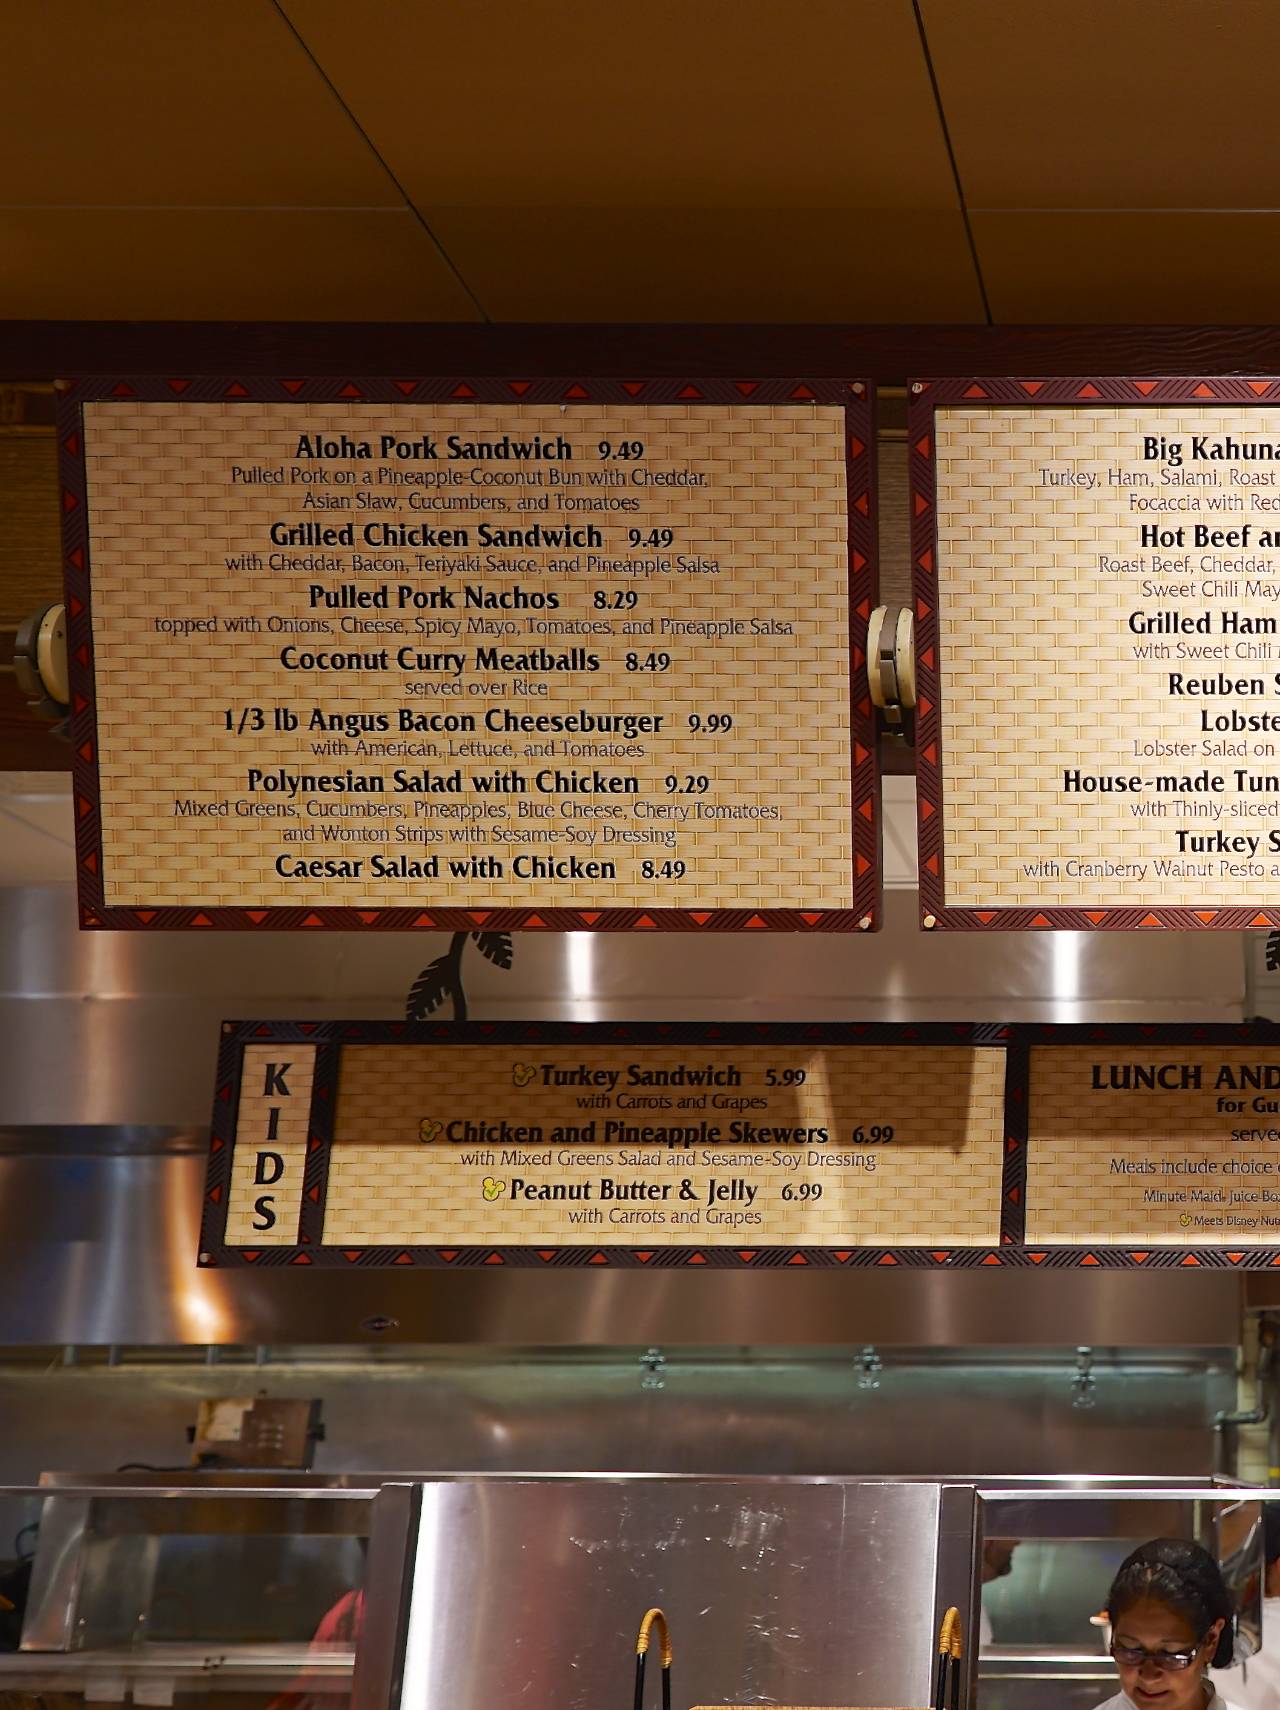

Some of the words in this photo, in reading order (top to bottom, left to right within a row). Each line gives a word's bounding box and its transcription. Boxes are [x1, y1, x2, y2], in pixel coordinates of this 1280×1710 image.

[297, 435, 372, 458] Aloha
[381, 436, 437, 459] Pork
[448, 436, 571, 460] Sandwich
[599, 441, 644, 460] 9.49
[1144, 437, 1183, 466] Big
[232, 467, 283, 483] Pulled
[292, 467, 329, 483] Pork
[335, 472, 355, 483] on
[362, 472, 372, 484] a
[379, 468, 542, 489] Pineapple-Coconut
[550, 468, 581, 484] Bun
[587, 469, 625, 484] with
[632, 469, 708, 487] Cheddar,
[303, 492, 350, 508] Asian
[356, 493, 401, 511] Slaw,
[409, 492, 510, 511] Cucumbers,
[518, 494, 548, 510] and
[554, 494, 639, 510] Tomatoes
[1130, 494, 1200, 510] Focaccia
[1206, 494, 1243, 510] with
[1251, 494, 1280, 510] Red
[271, 522, 354, 546] Grilled
[364, 523, 468, 547] Chicken
[478, 523, 602, 547] Sandwich
[629, 529, 673, 548] 9.49
[1141, 525, 1185, 547] Hot
[1195, 525, 1251, 547] Beef
[310, 585, 388, 608] Pulled
[399, 586, 455, 608] Pork
[465, 586, 559, 609] Nachos
[594, 591, 637, 609] 8.29
[1143, 580, 1196, 597] Sweet
[1202, 581, 1237, 597] Chili
[280, 646, 388, 670] Coconut
[397, 647, 465, 677] Curry
[476, 648, 599, 671] Meatballs
[626, 653, 670, 671] 8.49
[405, 680, 461, 695] served
[469, 684, 505, 695] over
[513, 679, 547, 696] Rice
[1169, 673, 1264, 695] Reuben
[1175, 830, 1259, 859] Turkey
[276, 854, 363, 877] Caesar
[371, 855, 439, 877] Salad
[448, 856, 503, 878] with
[513, 856, 616, 878] Chicken
[642, 861, 685, 879] 8.49
[542, 1065, 619, 1091] Turkey
[628, 1065, 740, 1086] Sandwich
[767, 1069, 805, 1086] 5.99
[1092, 1065, 1202, 1089] LUNCH
[577, 1094, 611, 1108] with
[616, 1093, 672, 1109] Carrots
[677, 1094, 707, 1109] and
[712, 1094, 767, 1113] Grapes
[1217, 1098, 1245, 1112] for
[511, 1179, 592, 1200] Peanut
[600, 1179, 671, 1200] Butter
[679, 1179, 697, 1200] &
[707, 1180, 758, 1207] Jelly
[782, 1184, 822, 1200] 6.99
